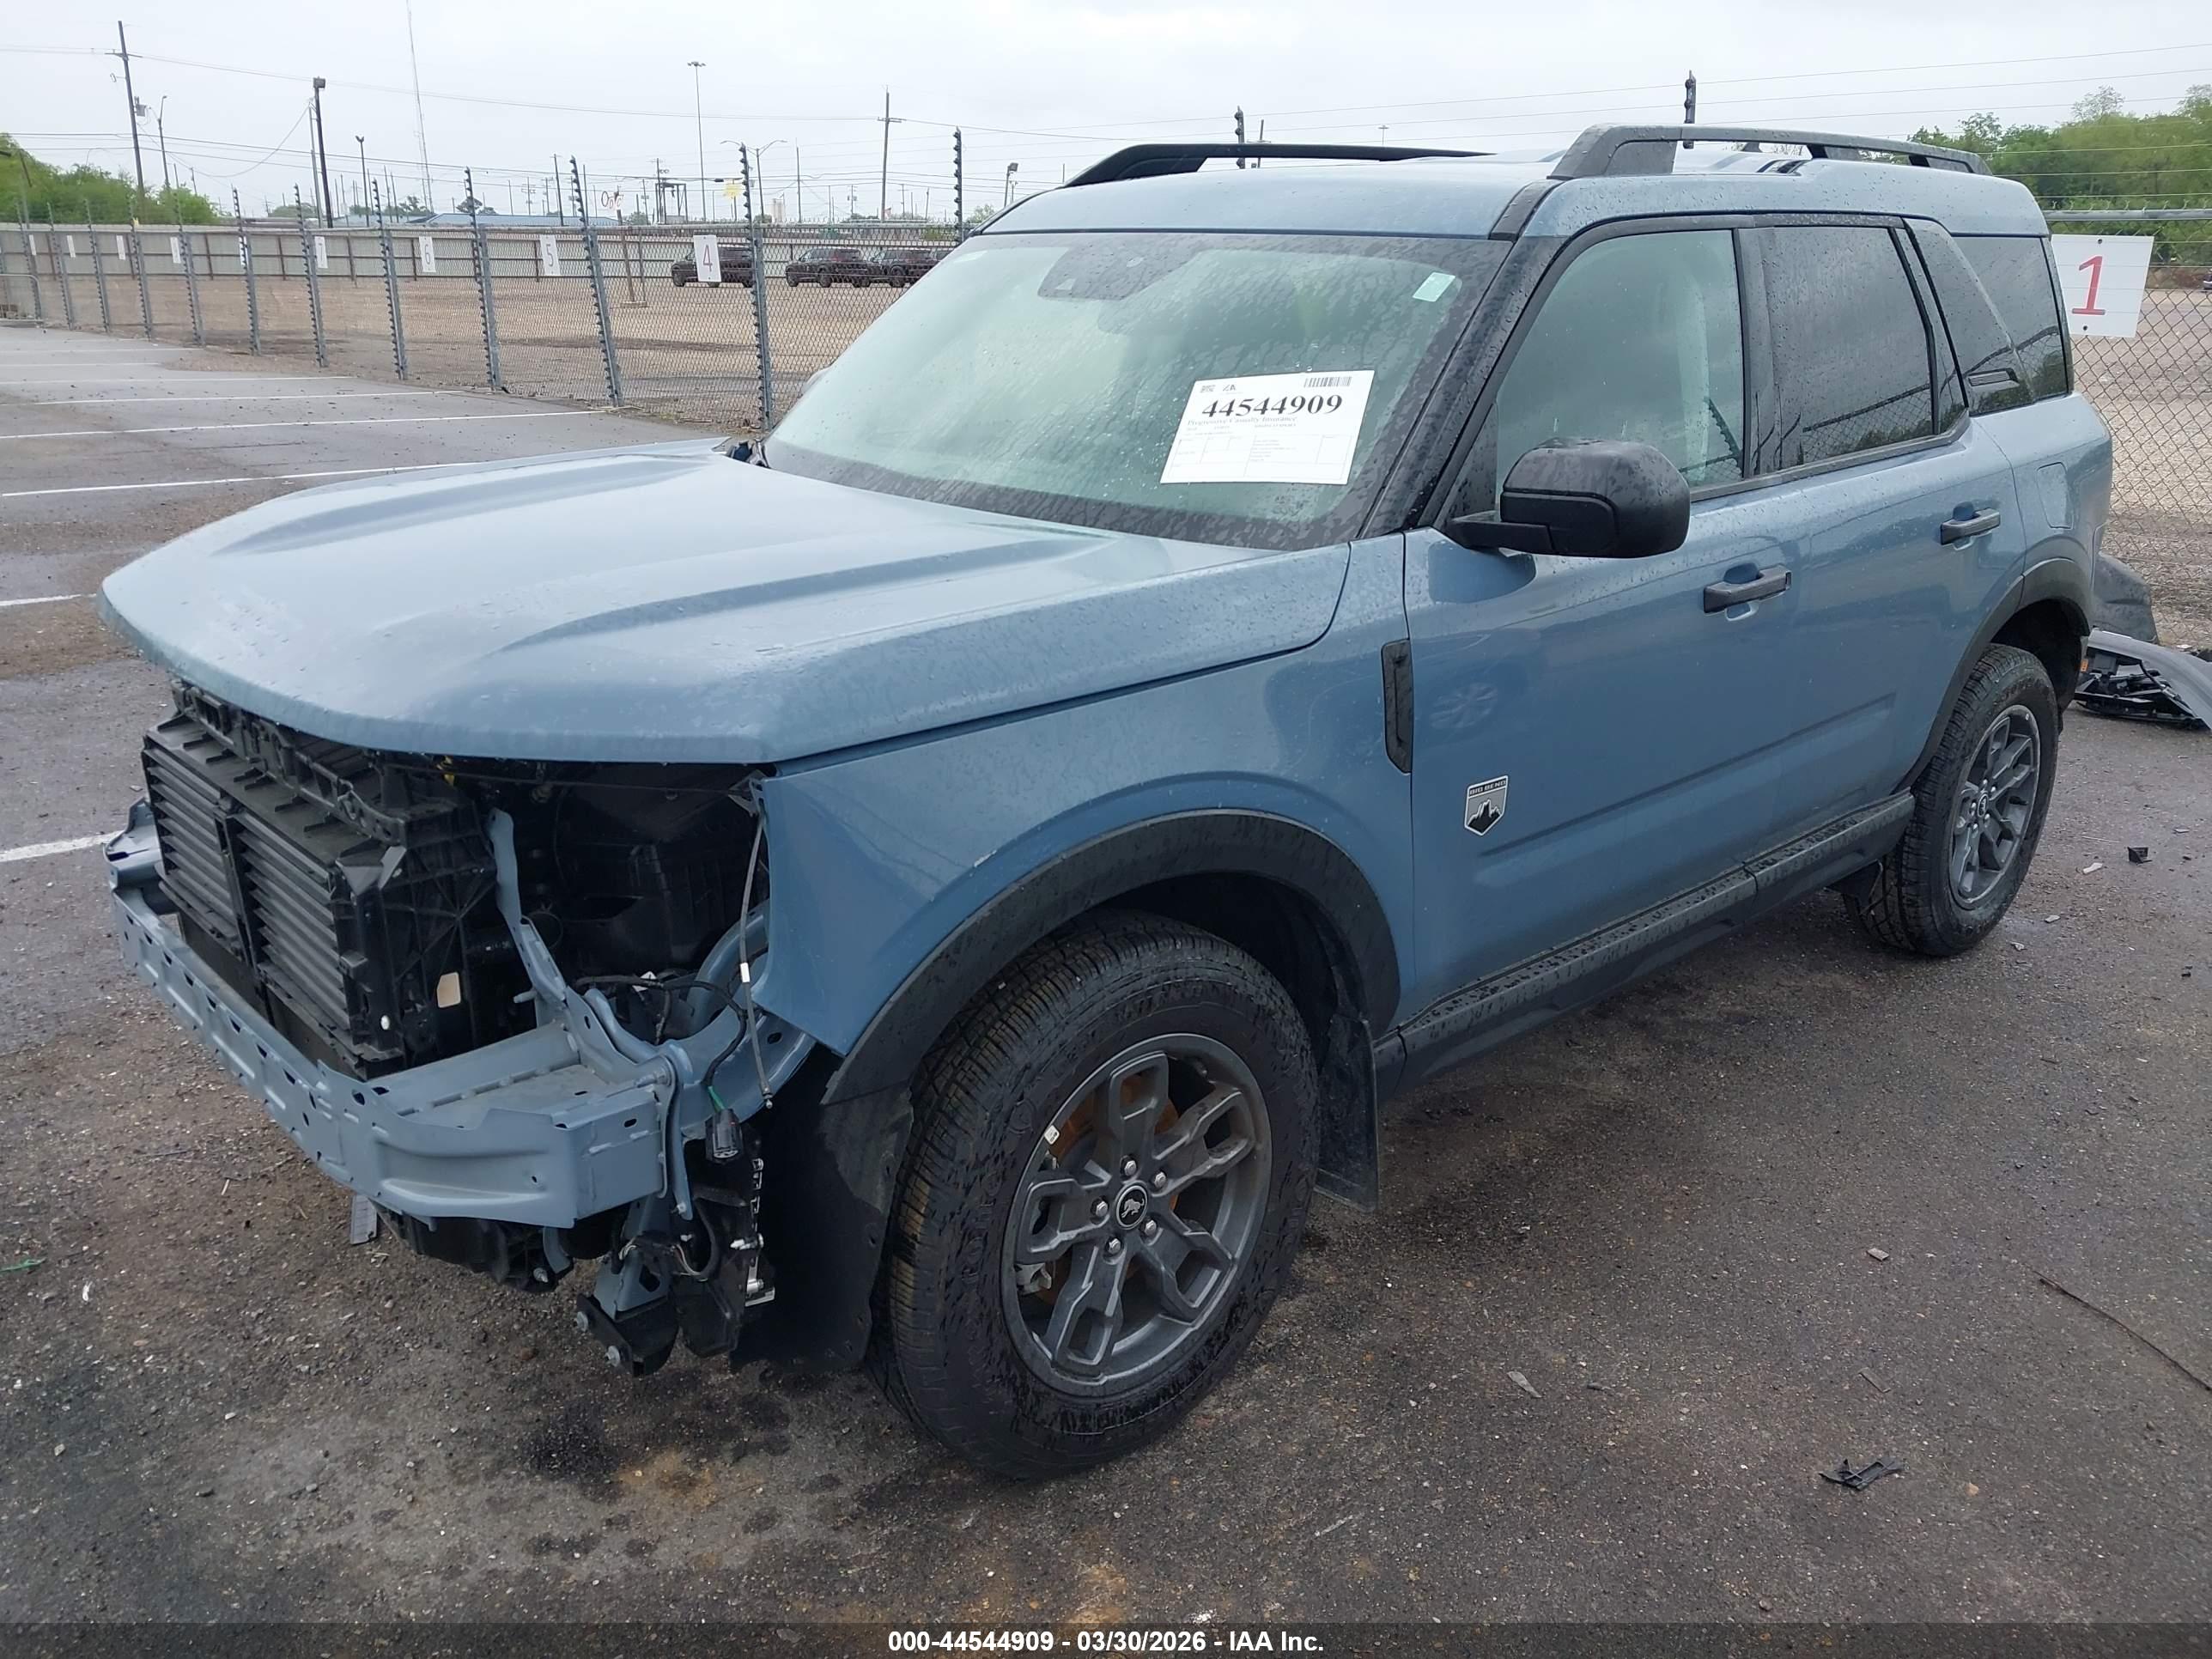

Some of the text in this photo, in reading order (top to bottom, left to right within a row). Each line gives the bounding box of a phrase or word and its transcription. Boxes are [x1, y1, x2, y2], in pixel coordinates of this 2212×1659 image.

[424, 244, 431, 265] 6
[545, 244, 555, 267] 5
[703, 245, 713, 271] 4
[2072, 256, 2106, 315] 1
[1201, 394, 1343, 418] 44544909
